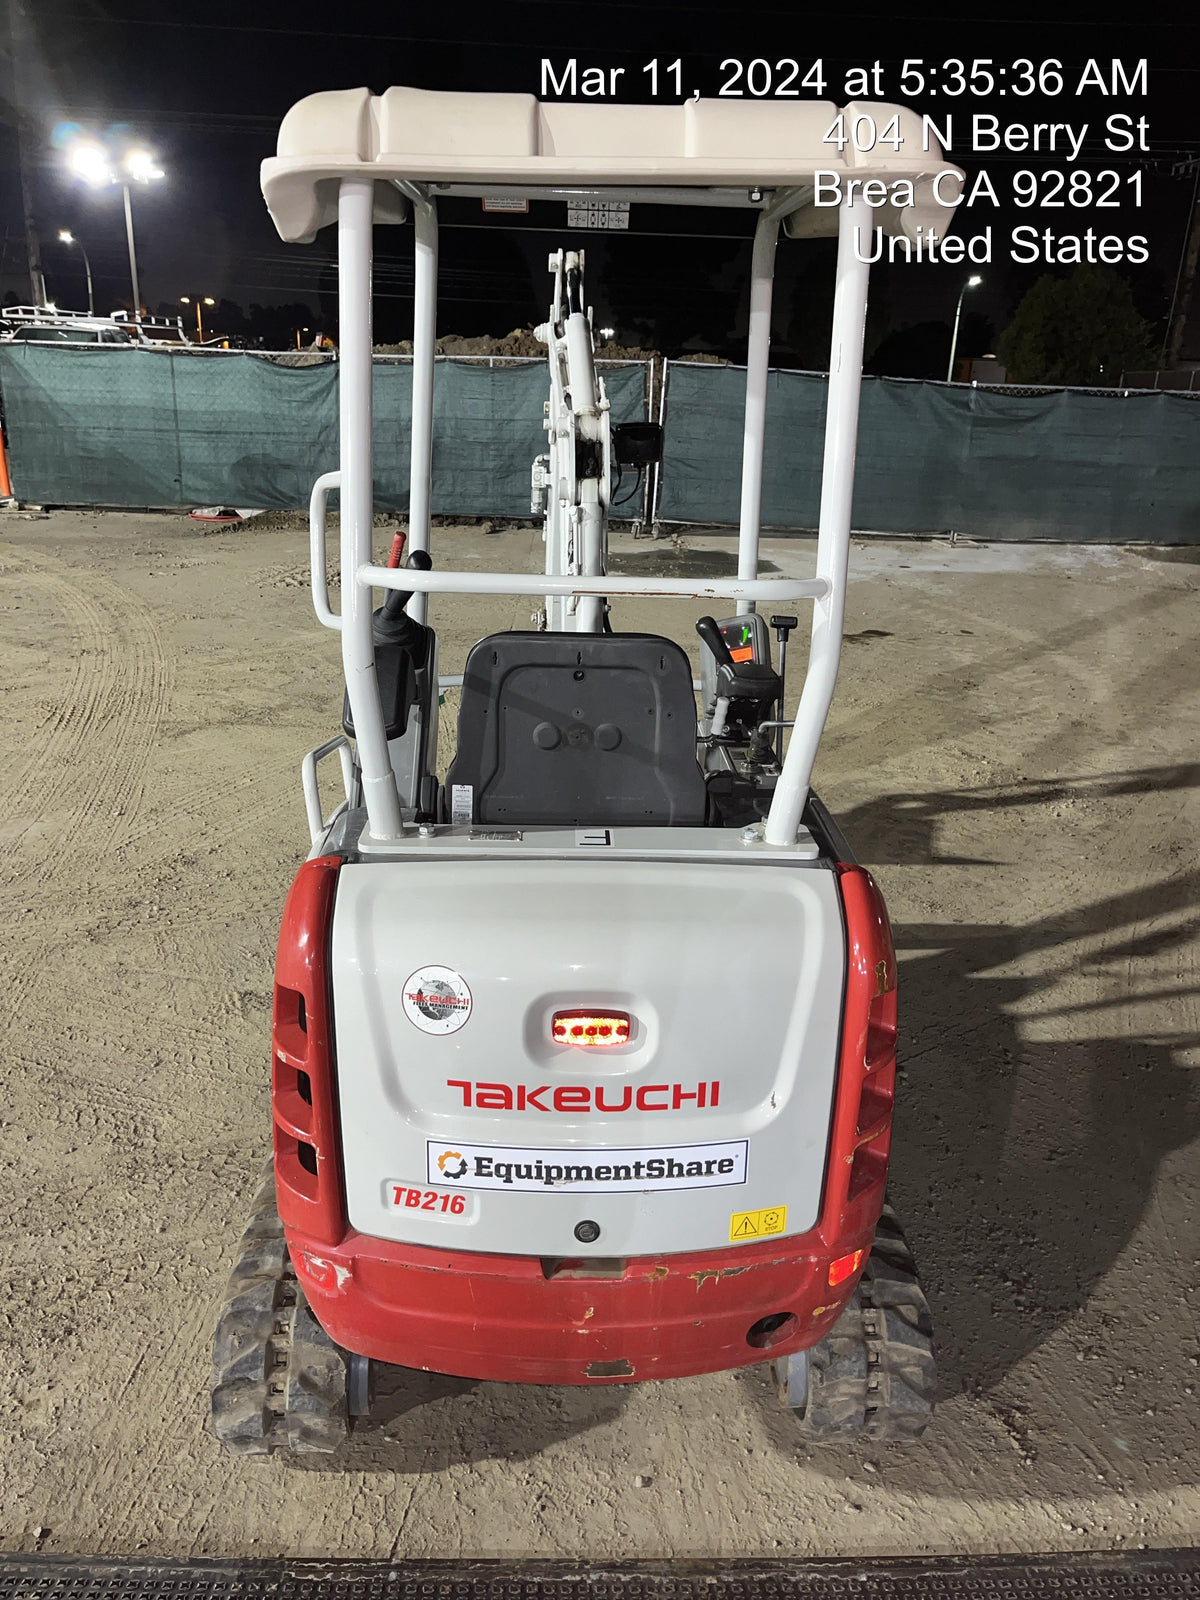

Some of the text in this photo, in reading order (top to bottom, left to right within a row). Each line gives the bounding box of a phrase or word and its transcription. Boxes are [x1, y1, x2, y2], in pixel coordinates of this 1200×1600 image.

[405, 993, 469, 1005] TAKEUCHI
[447, 1080, 720, 1112] TAKEUCHI
[474, 1156, 735, 1185] EquipmentShare
[392, 1186, 467, 1215] TB216
